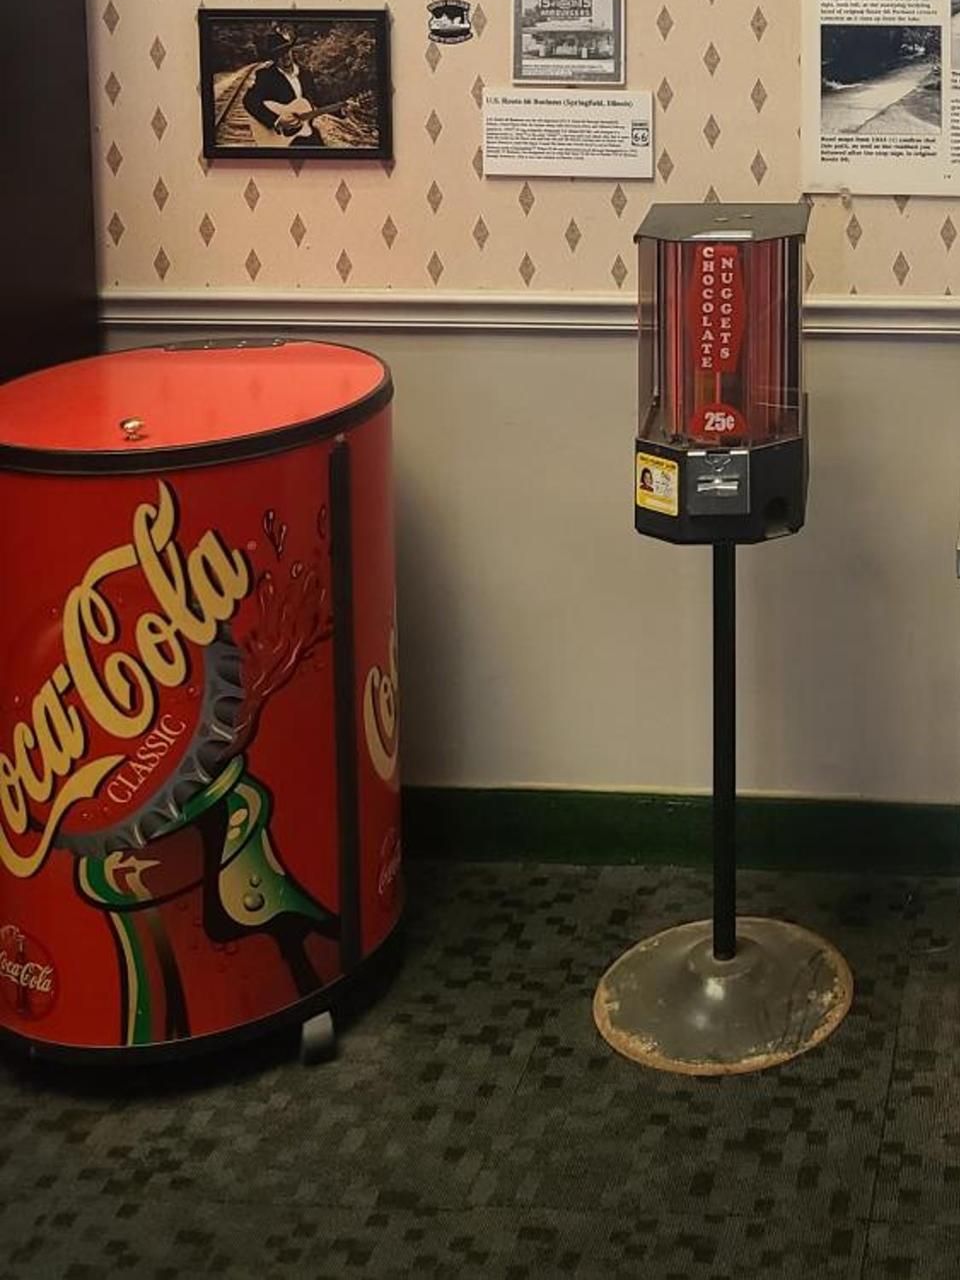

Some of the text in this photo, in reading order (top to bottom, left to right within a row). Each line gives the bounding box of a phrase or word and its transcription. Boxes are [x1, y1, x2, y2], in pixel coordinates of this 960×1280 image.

[701, 245, 715, 369] CHOCOLATE
[720, 257, 734, 360] NUGGETS
[0, 479, 249, 878] oca-Cola
[107, 714, 187, 805] CLASSIC
